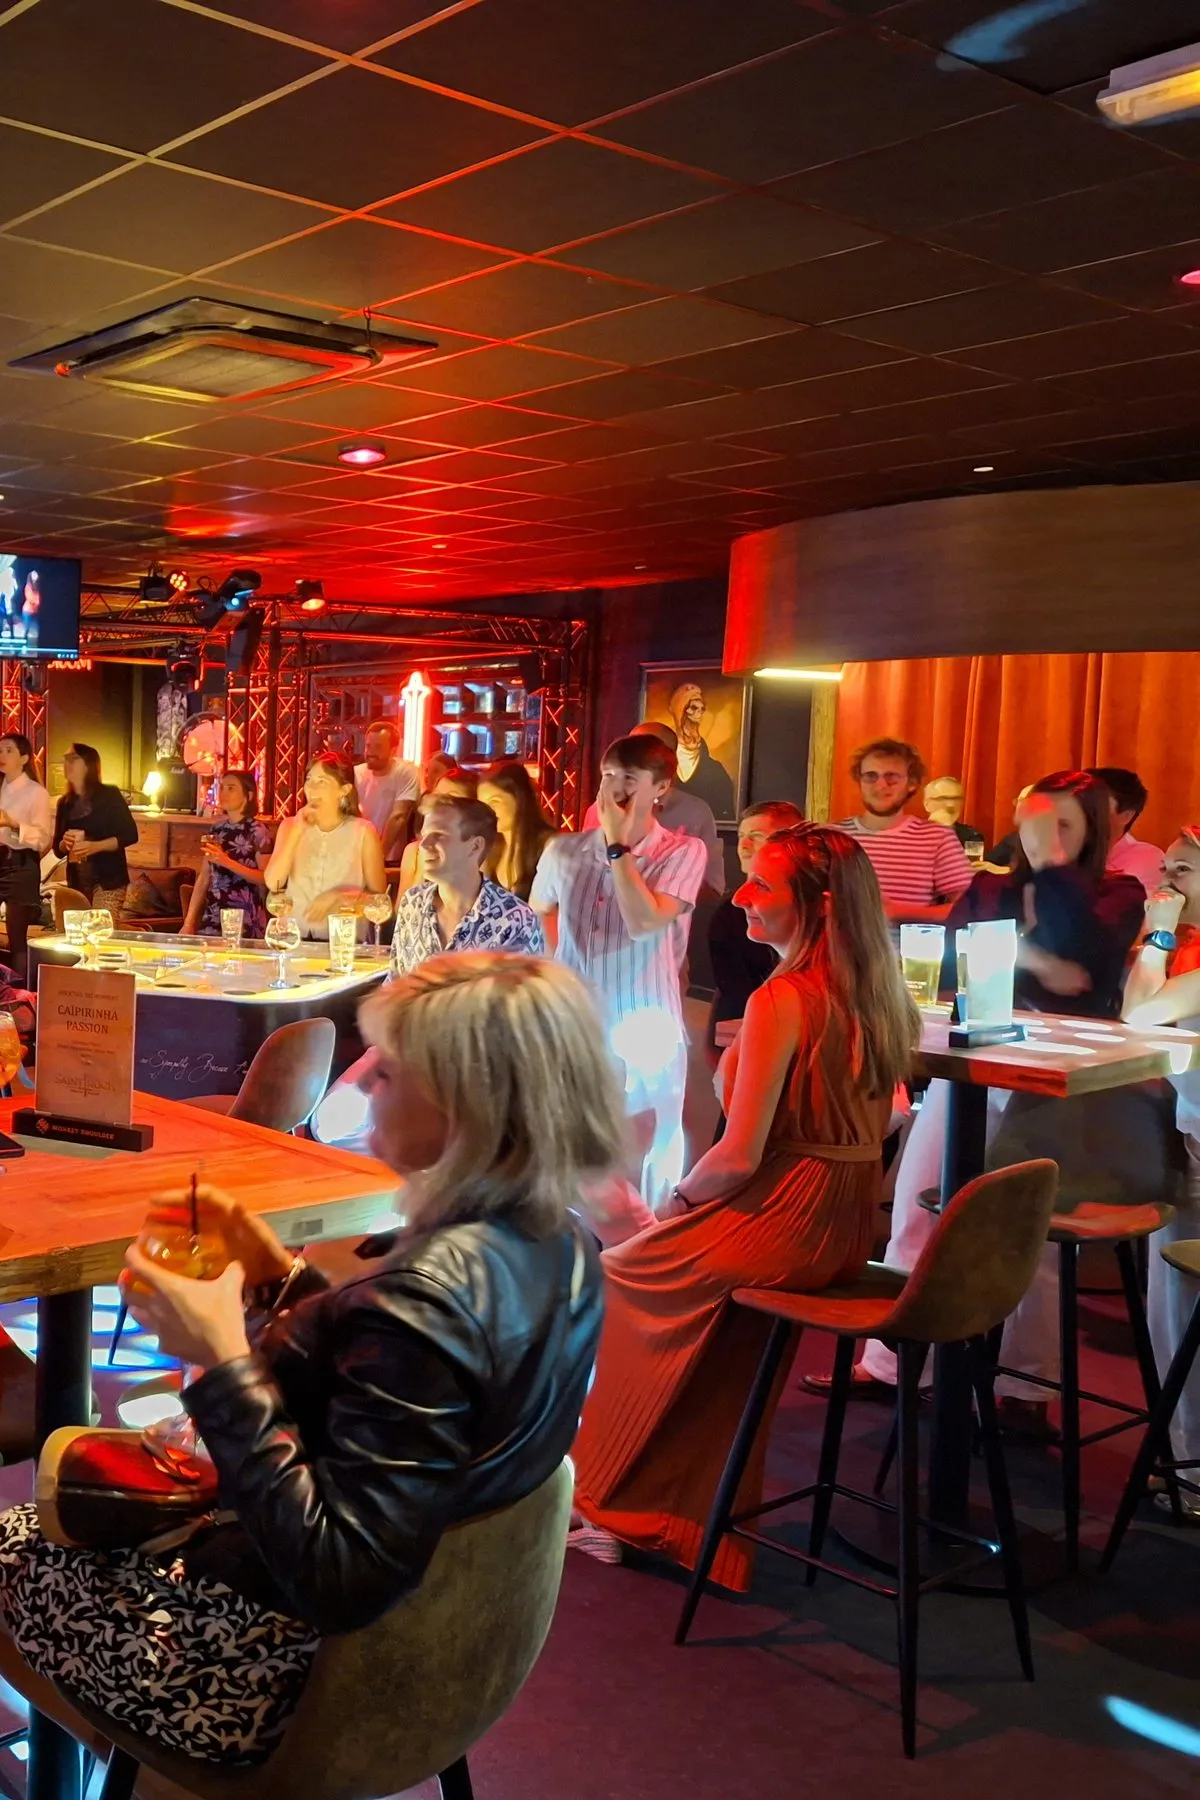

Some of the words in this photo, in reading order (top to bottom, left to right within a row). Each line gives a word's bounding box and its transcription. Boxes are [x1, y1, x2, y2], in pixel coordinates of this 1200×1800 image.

[66, 1020, 109, 1034] PASSION
[52, 1125, 79, 1134] MONKEY
[80, 1129, 115, 1140] SHOULDER
